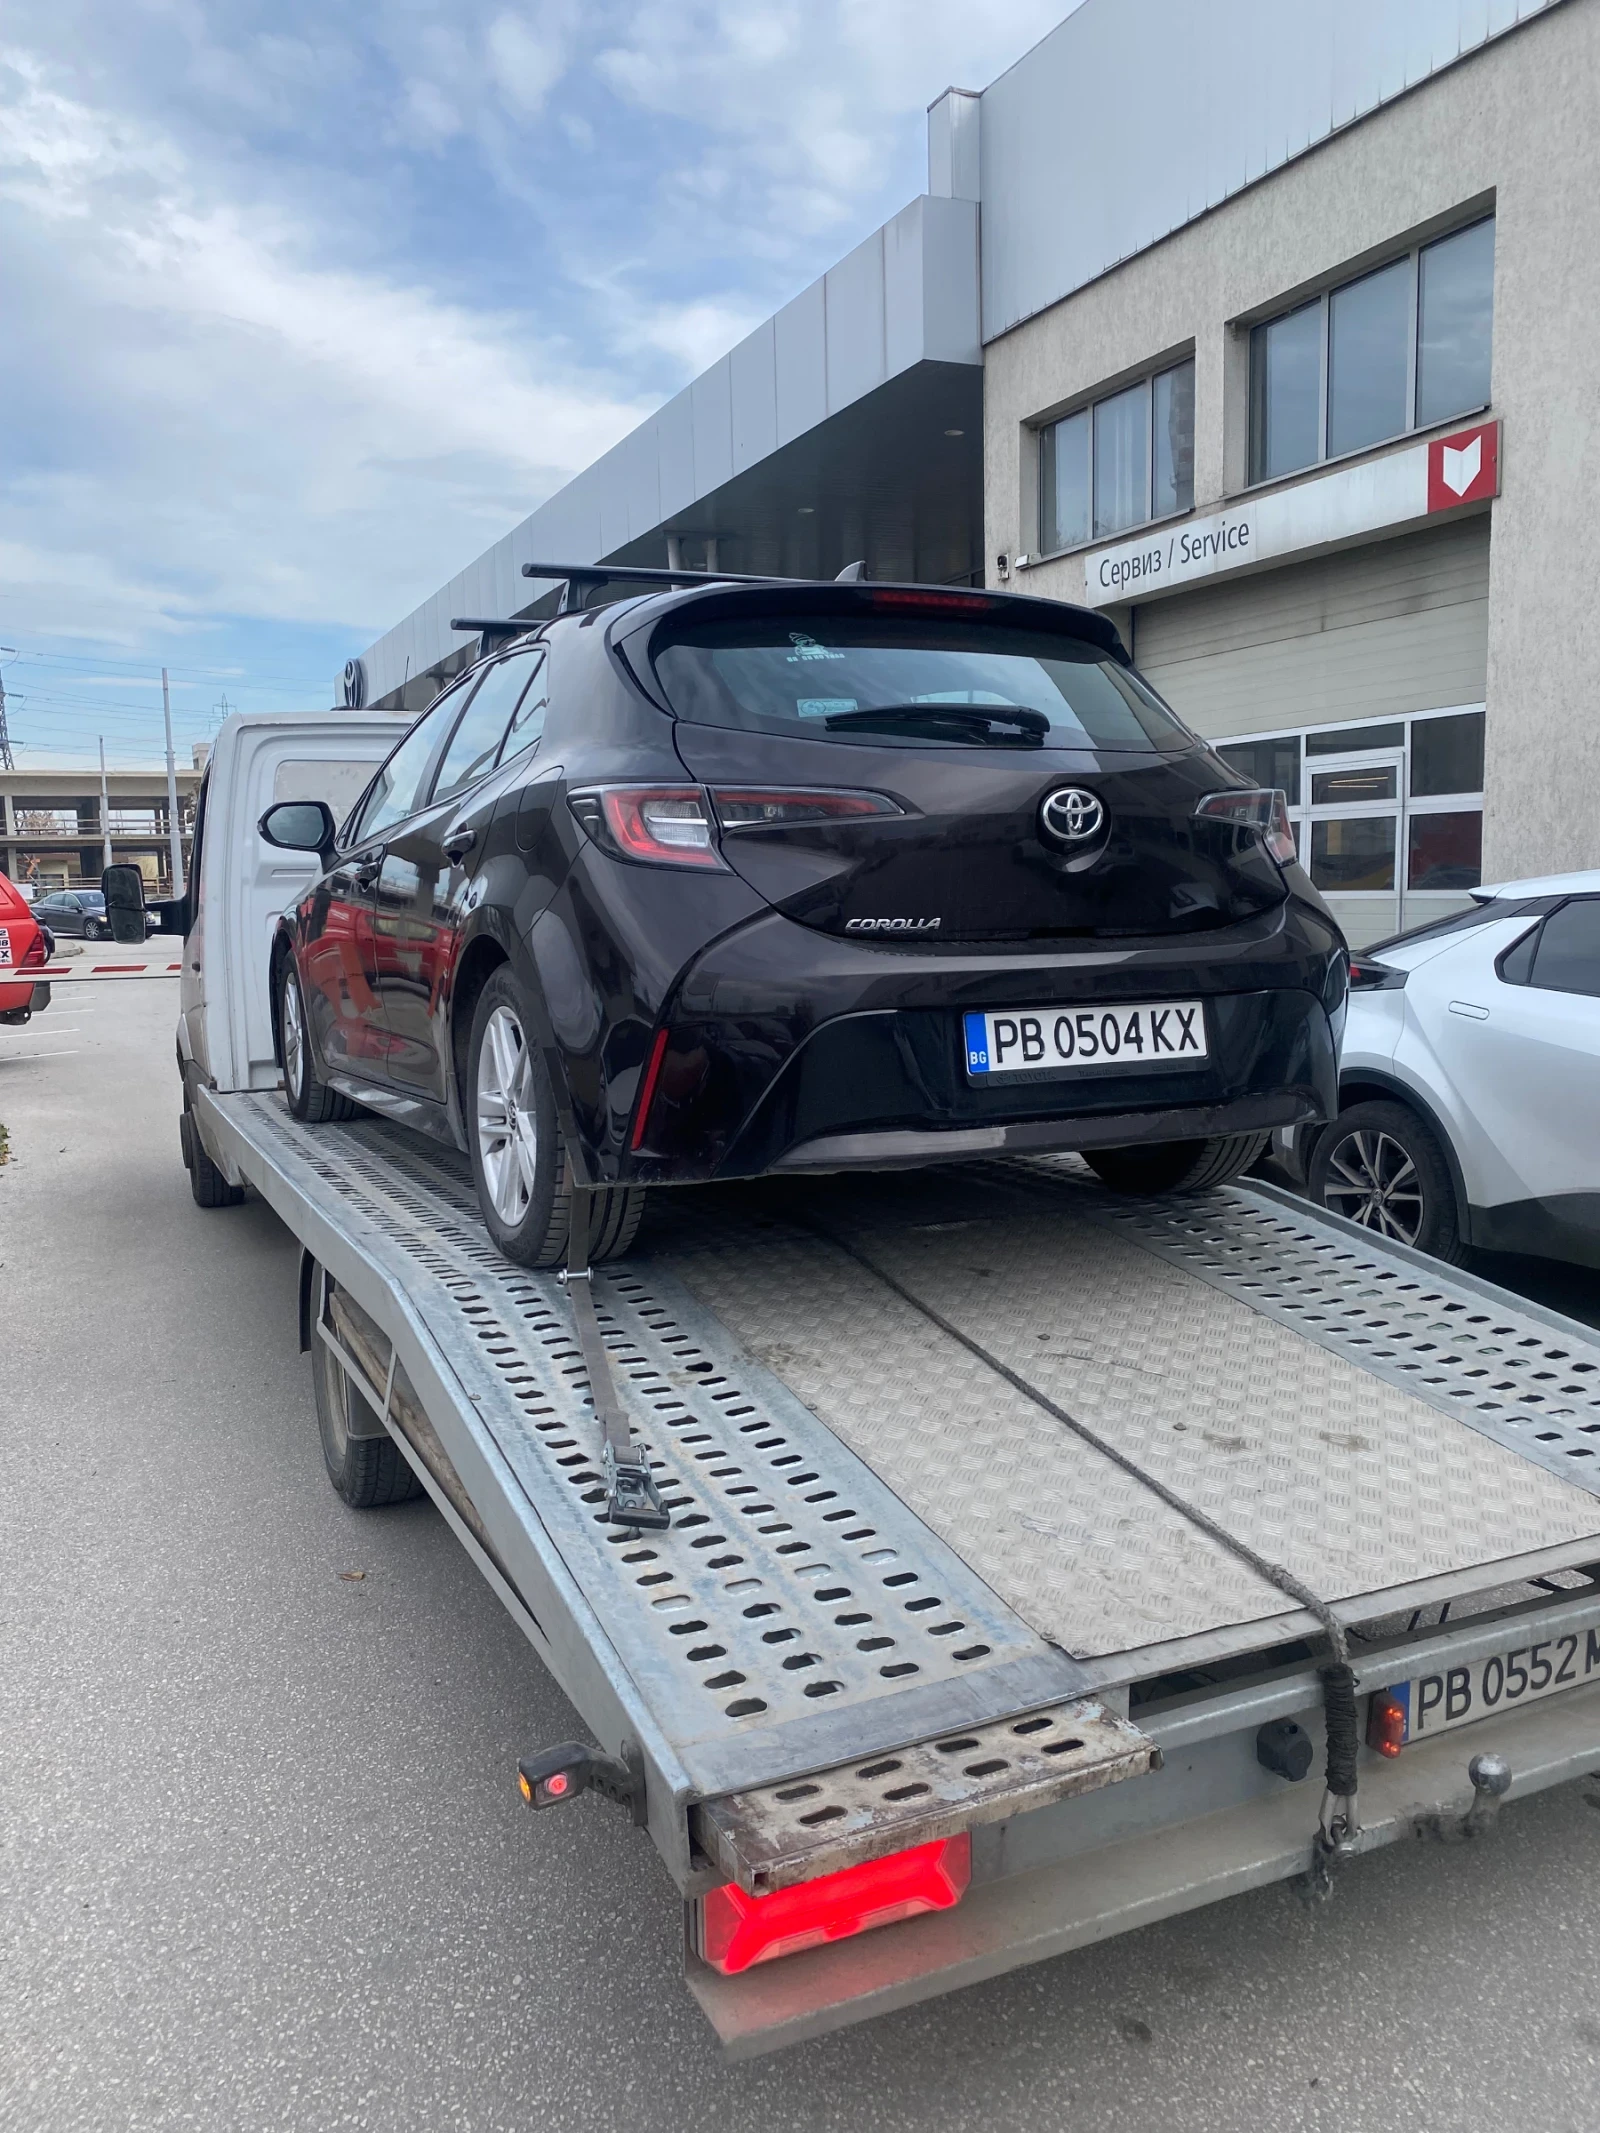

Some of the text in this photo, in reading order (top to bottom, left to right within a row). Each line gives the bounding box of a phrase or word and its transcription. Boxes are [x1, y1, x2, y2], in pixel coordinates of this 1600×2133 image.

[1100, 521, 1250, 590] Сервиз / Service
[845, 918, 941, 931] COROLLA
[970, 1051, 987, 1065] BG
[994, 1008, 1199, 1063] PB 0504 KX
[1417, 1666, 1472, 1730] PB
[1482, 1634, 1578, 1706] 0552
